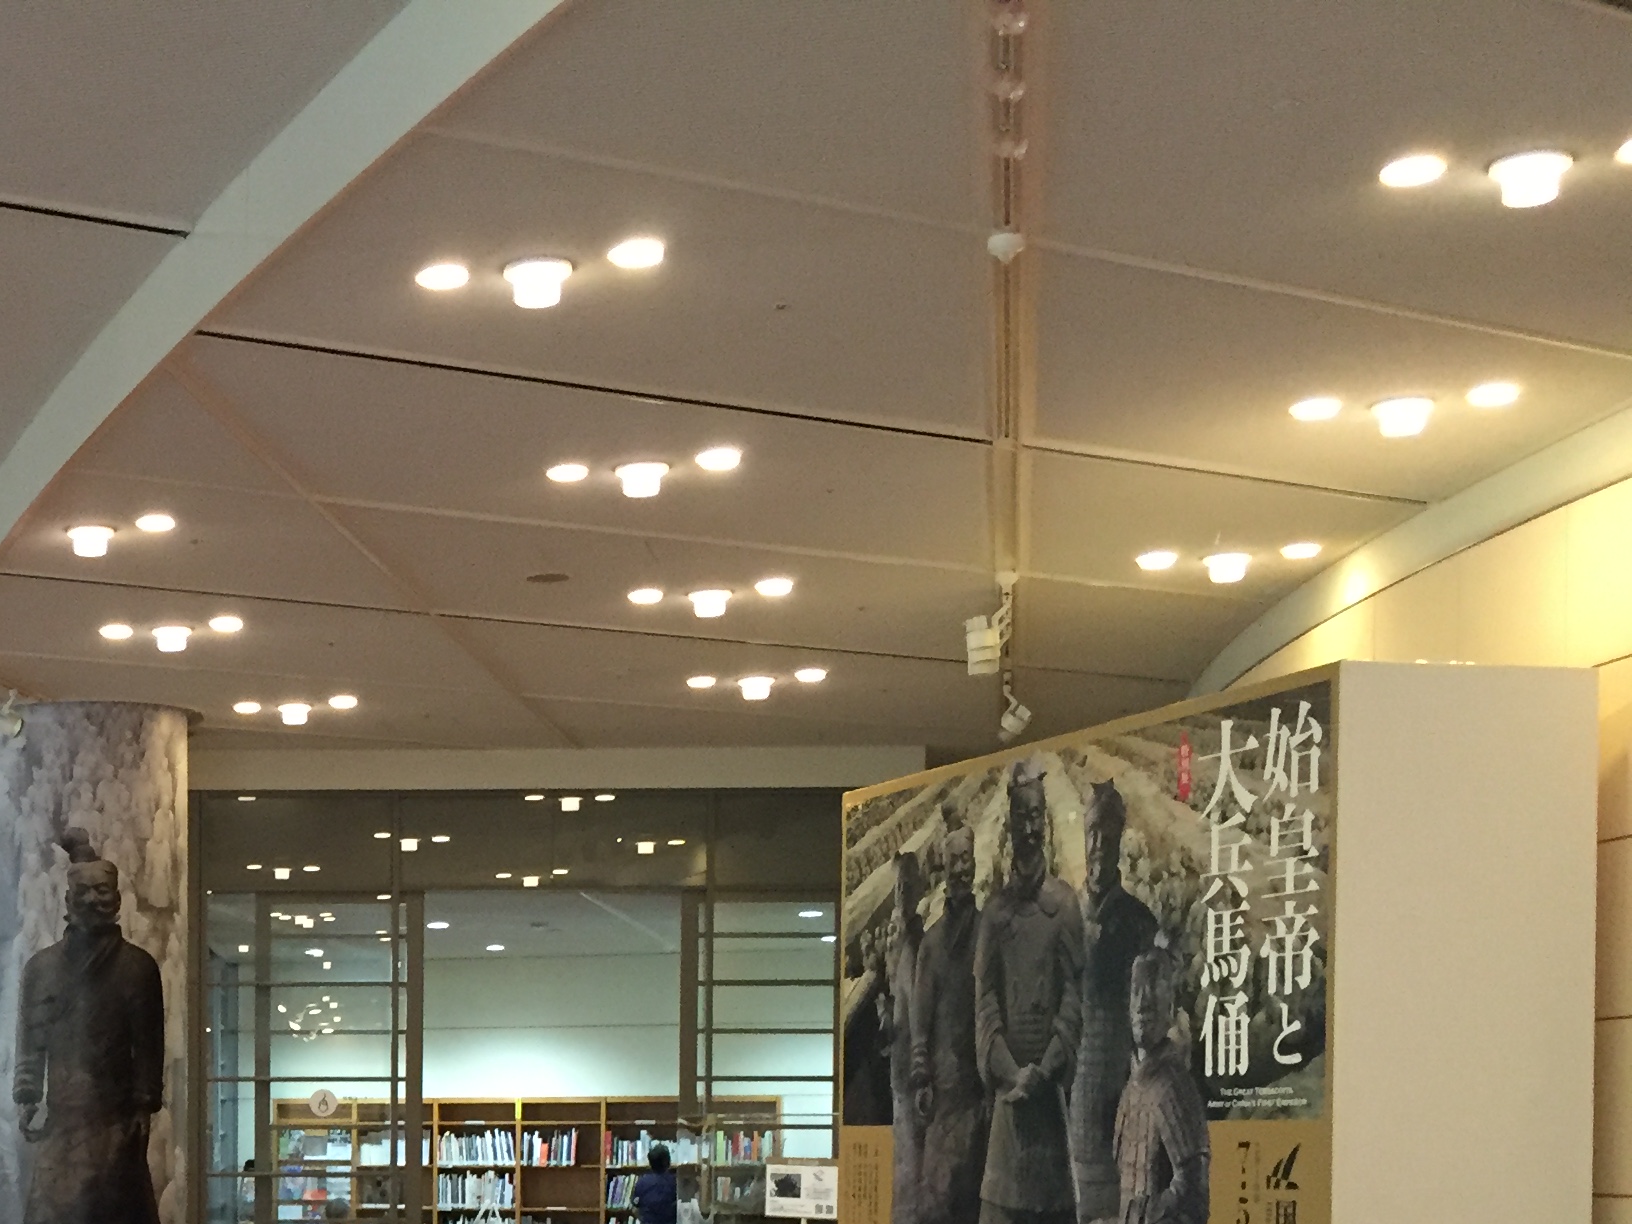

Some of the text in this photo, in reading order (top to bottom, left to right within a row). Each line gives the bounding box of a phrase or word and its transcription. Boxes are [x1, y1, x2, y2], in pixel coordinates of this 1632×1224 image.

[1198, 719, 1260, 1077] 大兵馬俑
[1259, 700, 1323, 1065] 始皇帝と
